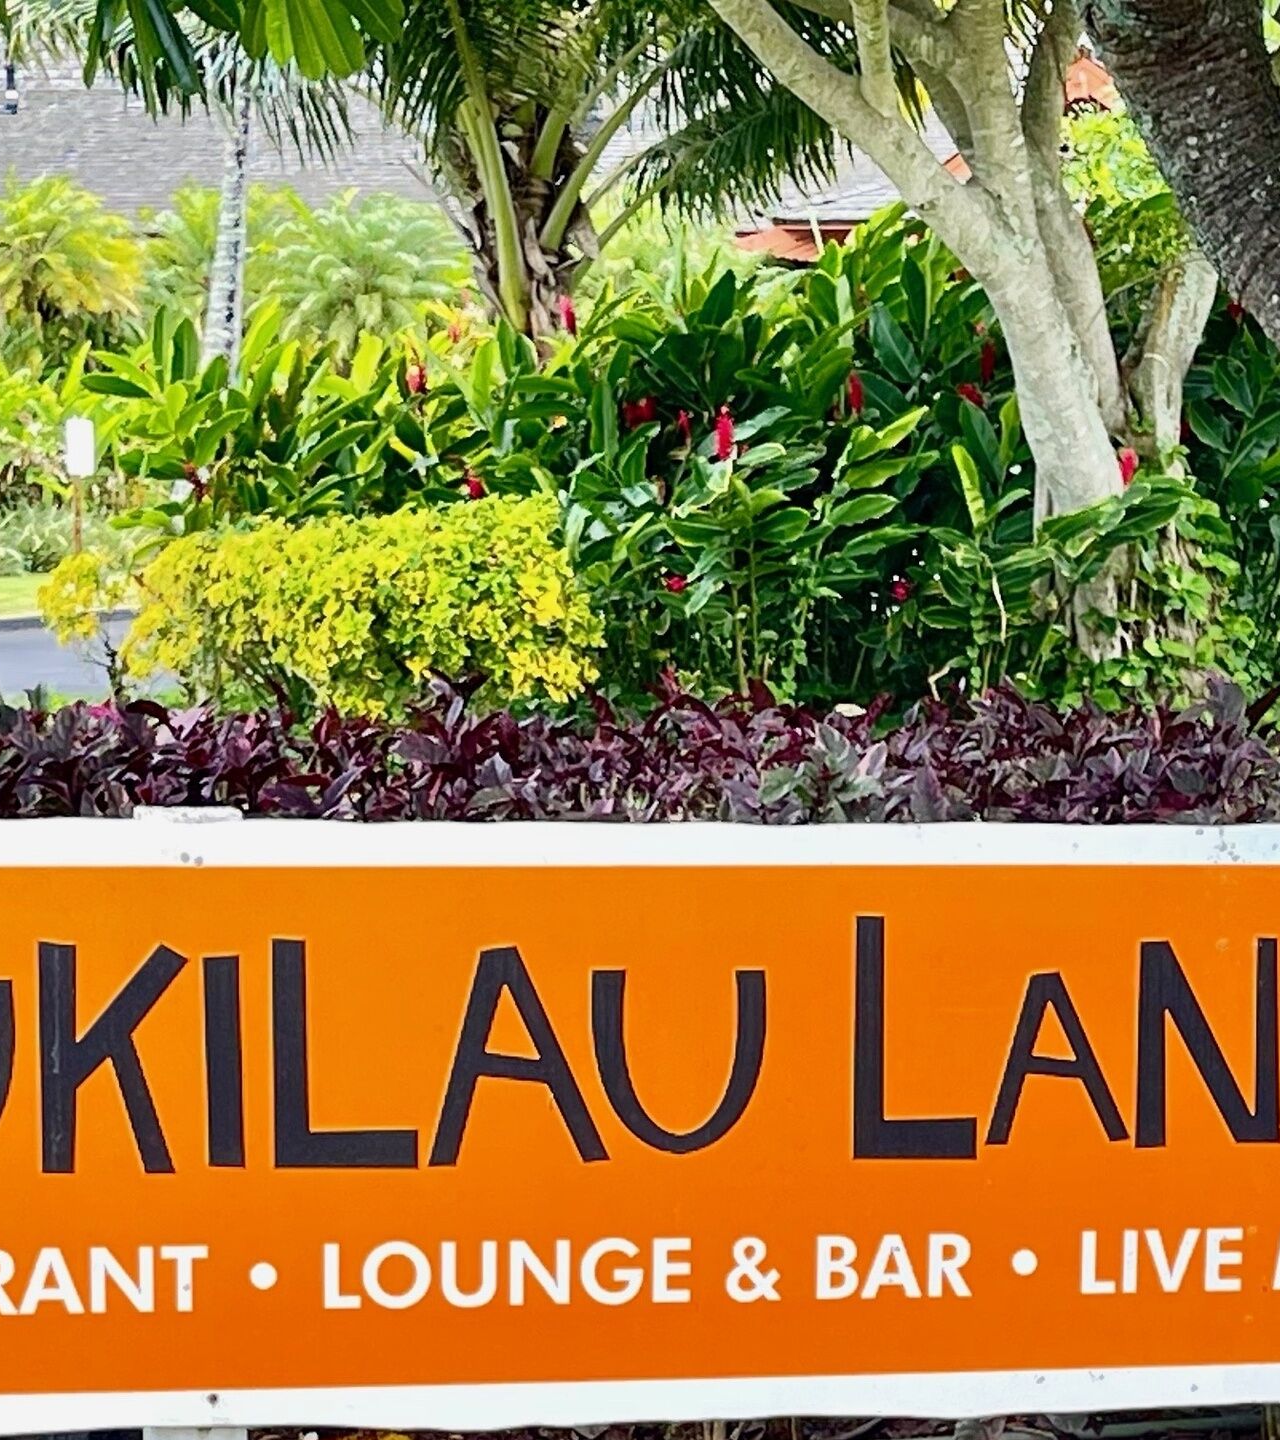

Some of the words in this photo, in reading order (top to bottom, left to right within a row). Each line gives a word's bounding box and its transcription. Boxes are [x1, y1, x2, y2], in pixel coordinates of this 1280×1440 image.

[322, 1237, 692, 1310] LOUNGE
[725, 1236, 781, 1303] &
[815, 1233, 972, 1300] BAR
[1079, 1227, 1244, 1294] LIVE
